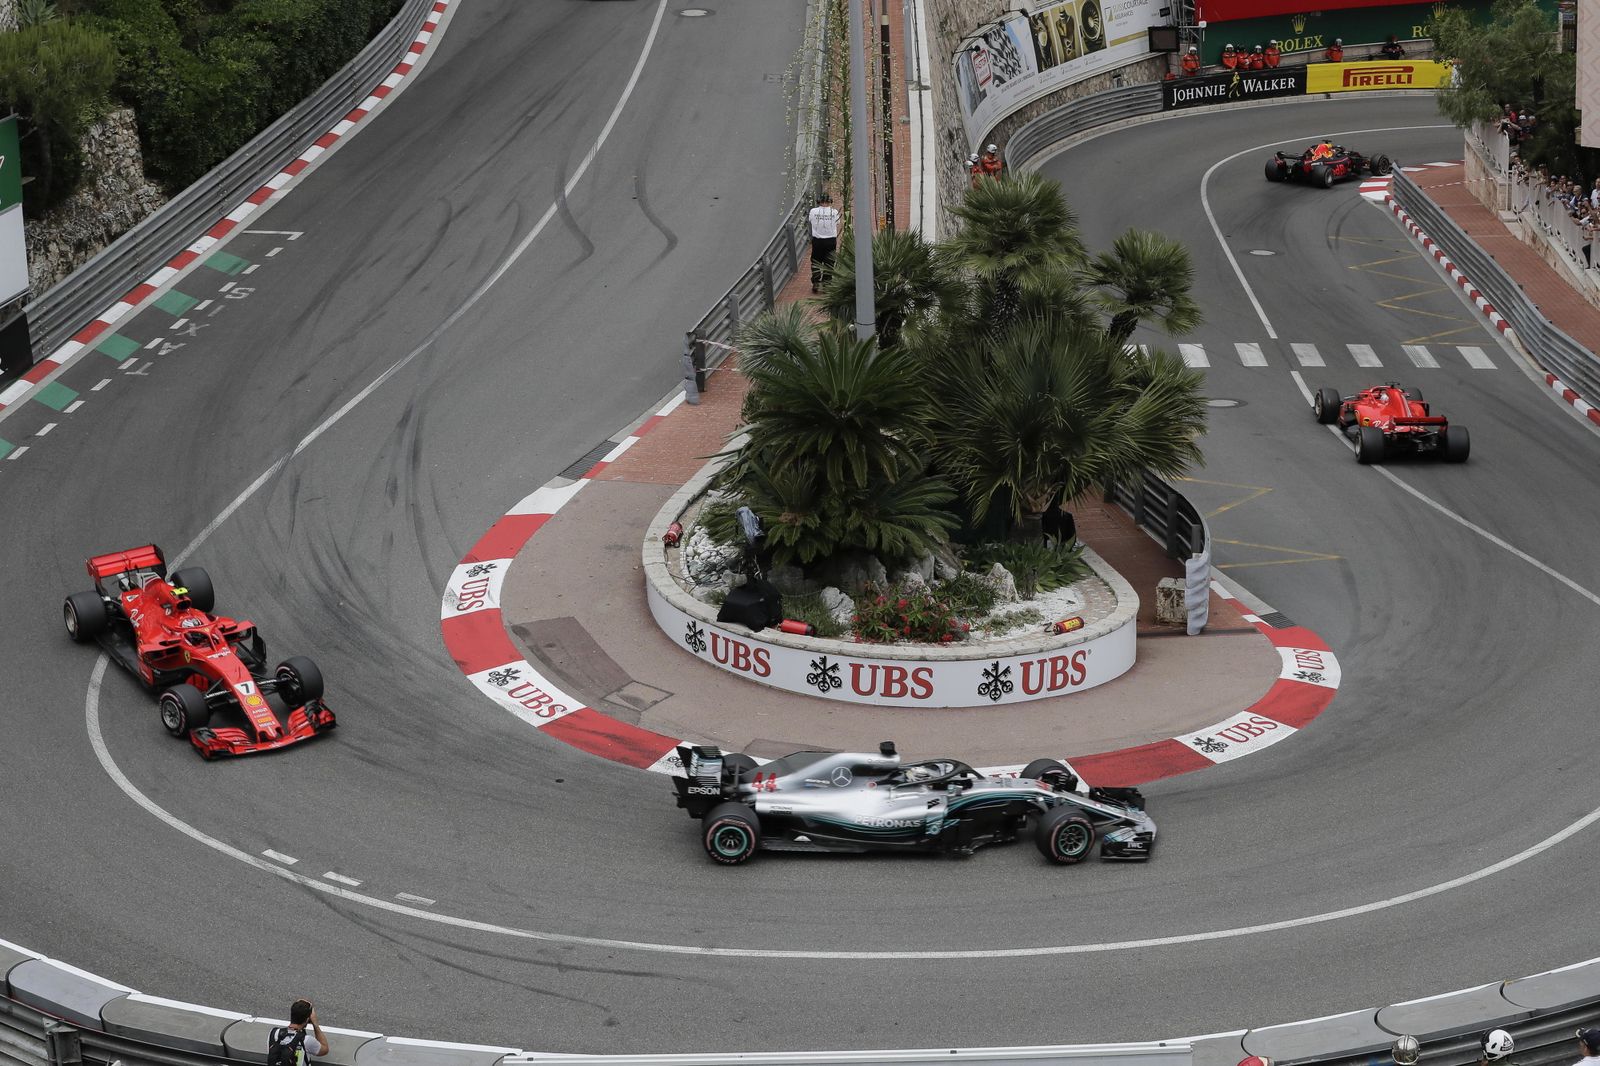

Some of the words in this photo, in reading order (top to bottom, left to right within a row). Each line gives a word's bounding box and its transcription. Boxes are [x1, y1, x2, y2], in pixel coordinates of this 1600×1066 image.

[1276, 34, 1324, 53] ROLEX
[1343, 66, 1413, 87] PIRELLI
[1172, 83, 1227, 107] JOHNNIE
[1243, 77, 1296, 94] WALKER
[457, 577, 490, 611] UBS
[709, 631, 772, 678] UBS
[1293, 648, 1325, 671] UBS
[849, 662, 935, 700] UBS
[1020, 649, 1087, 696] UBS
[240, 683, 251, 694] 7
[508, 681, 567, 718] UBS
[1215, 716, 1278, 744] UBS
[687, 786, 720, 795] EPSON
[752, 771, 777, 793] 44
[854, 815, 922, 828] PETRONAS
[1127, 841, 1143, 849] IWC
